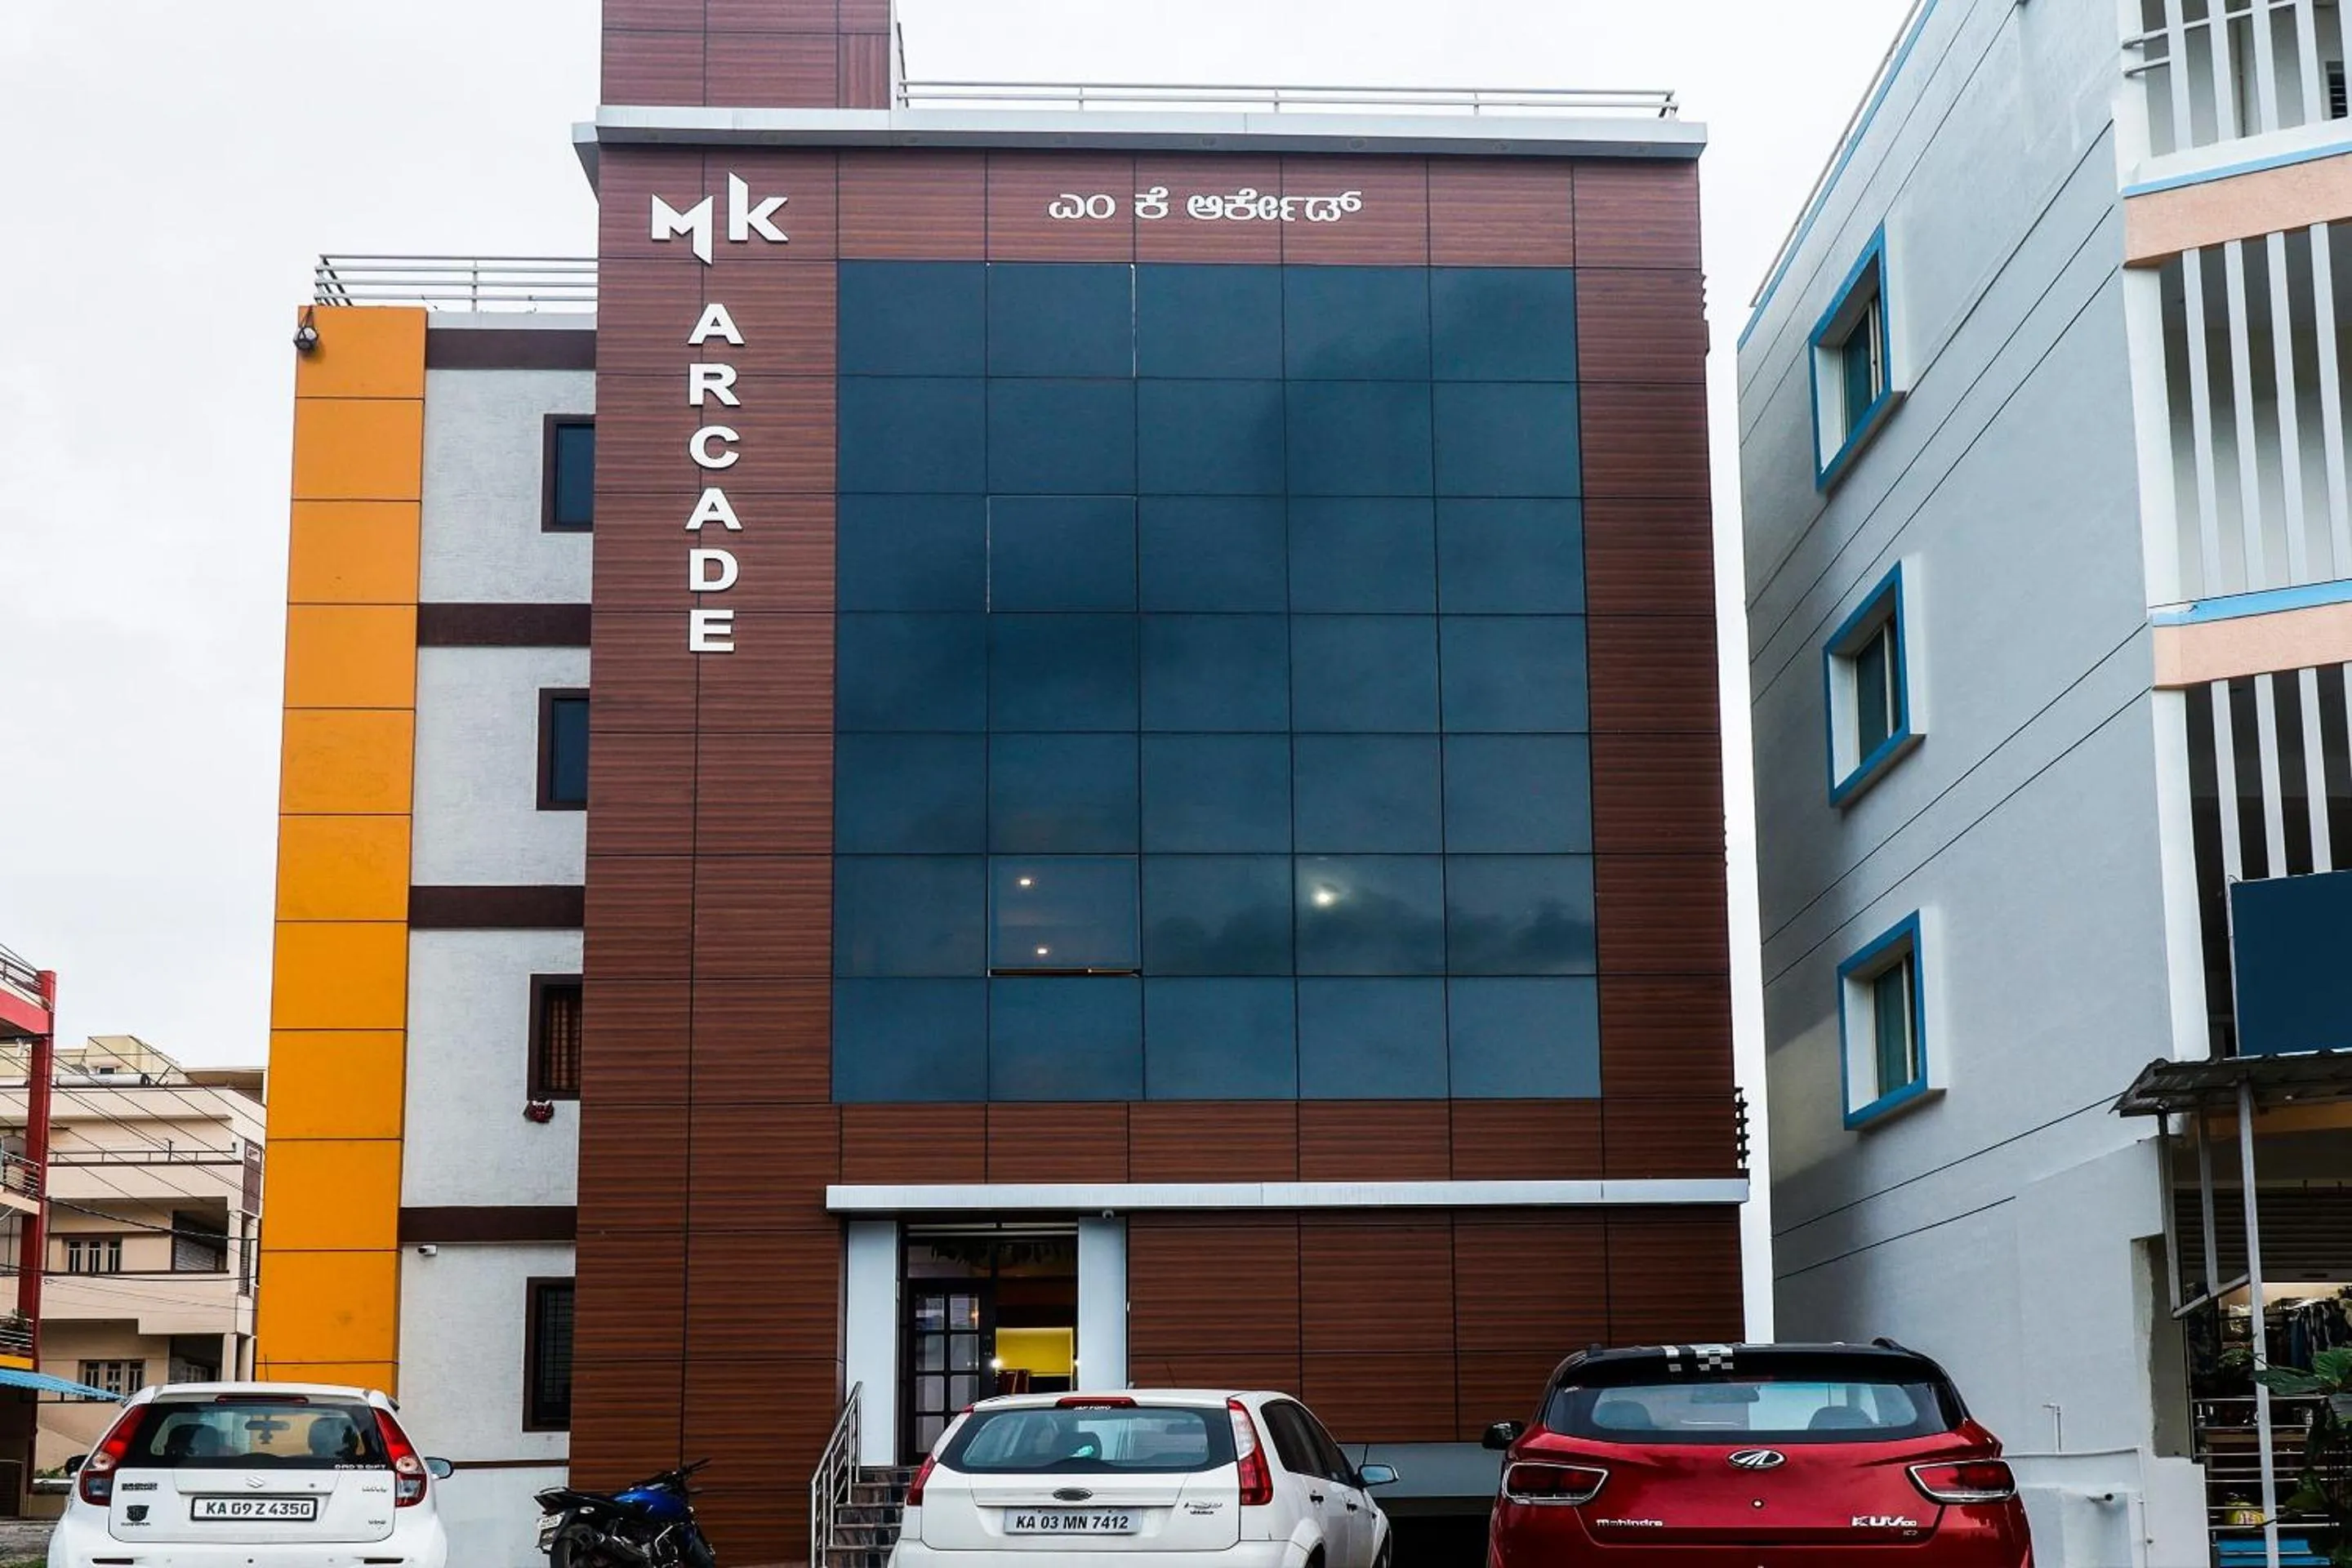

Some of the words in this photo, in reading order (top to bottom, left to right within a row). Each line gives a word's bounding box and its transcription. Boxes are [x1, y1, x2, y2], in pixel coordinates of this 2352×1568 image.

[1049, 194, 1116, 219] ಎಂ
[1134, 186, 1169, 219] ಕೆ
[684, 303, 745, 653] ARCADE
[206, 1502, 227, 1515] KA
[231, 1503, 252, 1515] 09
[255, 1503, 265, 1515] Z
[268, 1503, 310, 1515] 4350
[1015, 1516, 1036, 1530] KA
[1040, 1516, 1059, 1530] 03
[1062, 1516, 1088, 1530] MN
[1092, 1516, 1129, 1530] 7412
